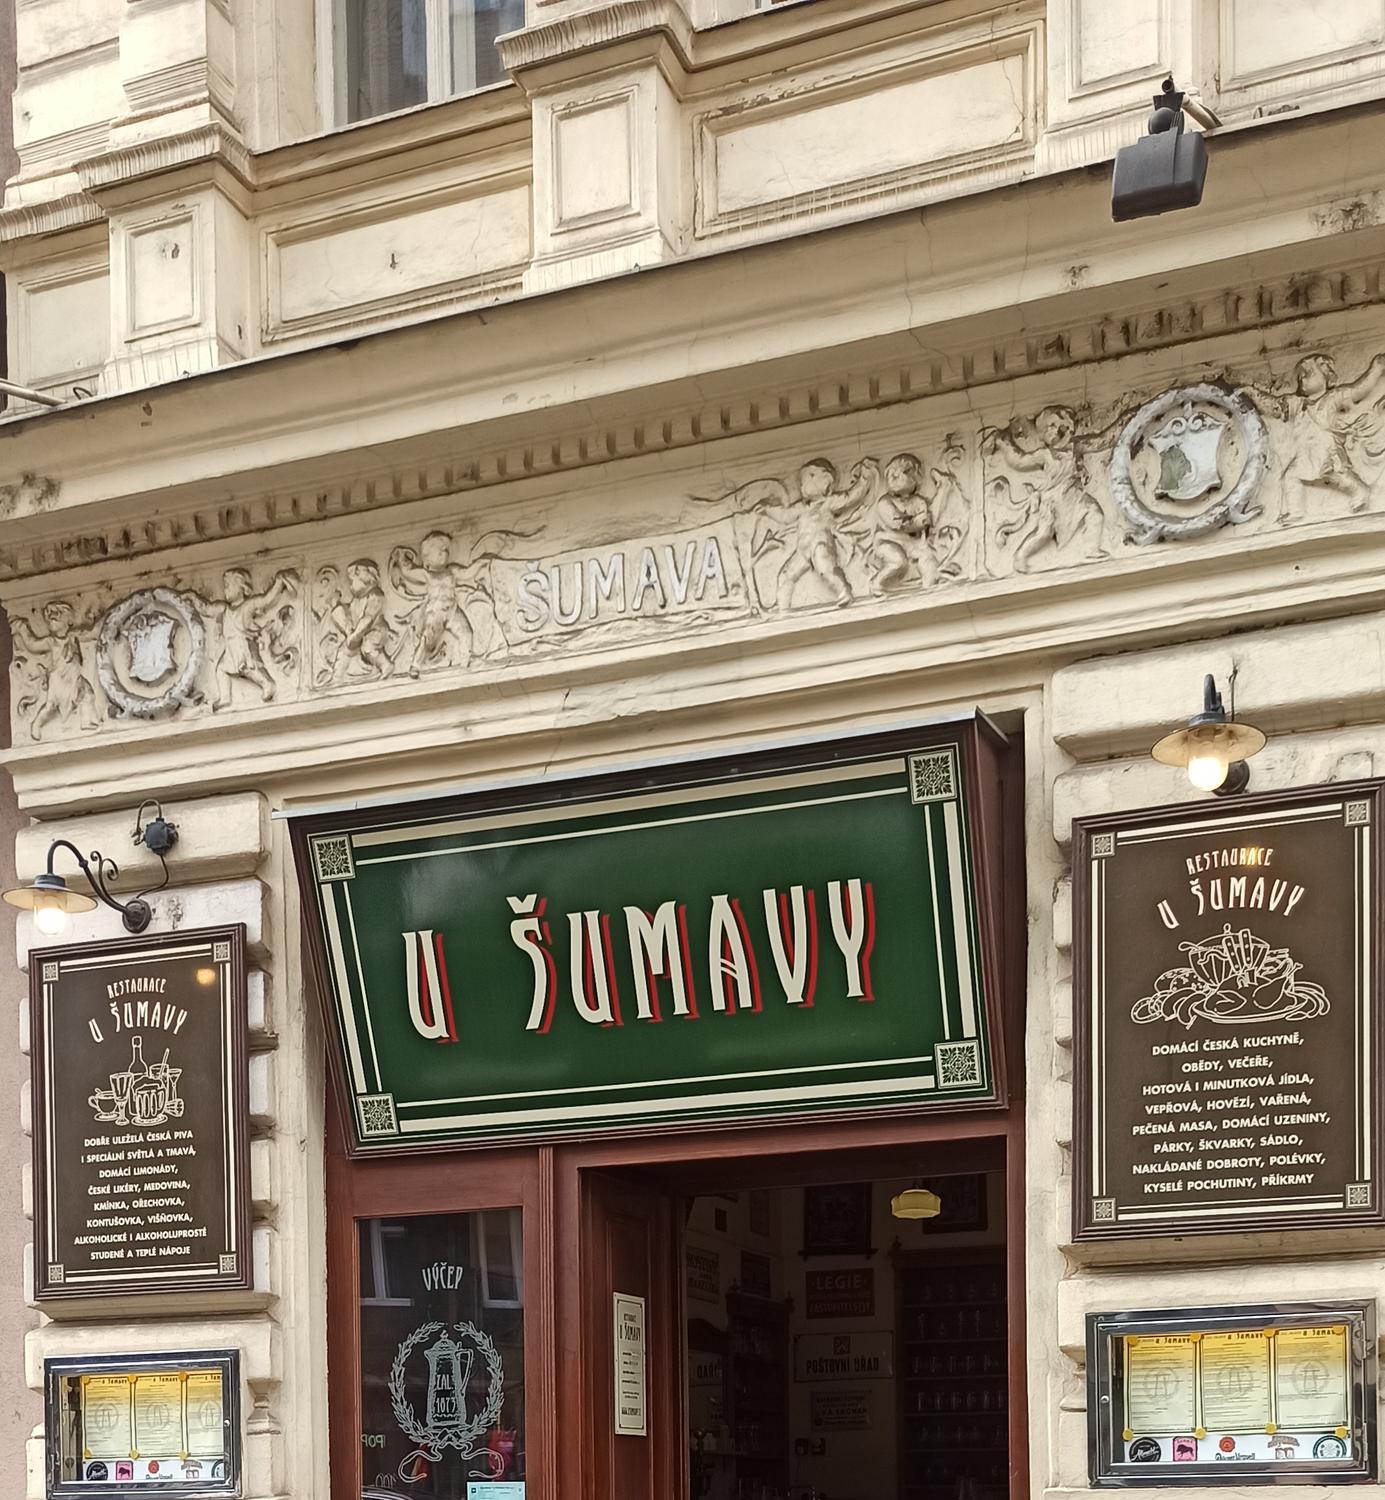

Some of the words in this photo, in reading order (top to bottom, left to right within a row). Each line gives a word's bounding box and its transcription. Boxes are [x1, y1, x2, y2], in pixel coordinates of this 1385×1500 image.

[516, 535, 729, 633] ŠUMAVA
[1186, 847, 1274, 875] RESTAURACE
[1156, 899, 1179, 929] U
[1189, 875, 1305, 917] ŠUMAVY
[401, 929, 459, 1044] U
[506, 878, 875, 1035] ŠUMAVY
[107, 976, 166, 1000] RESTAURACE
[88, 1018, 105, 1043] U
[110, 1001, 188, 1035] ŠUMAVY
[1152, 1039, 1199, 1056] DOMÁCÍ
[1202, 1036, 1239, 1052] ČESKÁ
[1243, 1031, 1305, 1048] KUCHYNĚ,
[1181, 1059, 1224, 1073] OBĚDY,
[1227, 1054, 1273, 1069] VEČEŘE,
[1142, 1080, 1192, 1096] HOTOVÁ
[1202, 1073, 1275, 1091] MINUTKOVÁ
[1278, 1072, 1315, 1086] JÍDLA,
[1145, 1099, 1203, 1115] VEPŘOVÁ,
[1206, 1095, 1255, 1111] HOVĚZÍ,
[1259, 1091, 1312, 1107] VAŘENÁ,
[1132, 1120, 1176, 1136] PEČENÁ
[1179, 1120, 1218, 1133] MASA,
[1222, 1113, 1270, 1129] DOMÁCÍ
[1273, 1111, 1331, 1126] UZENINY,
[84, 1135, 111, 1147] DOBŘE
[111, 1132, 145, 1145] ULEŽELÁ
[146, 1130, 172, 1142] ČESKÁ
[173, 1129, 194, 1140] PIVA
[1153, 1141, 1195, 1154] PÁRKY,
[1198, 1137, 1256, 1151] ŠKVARKY,
[1259, 1133, 1304, 1147] SÁDLO,
[86, 1150, 125, 1164] SPECIÁLNÍ
[127, 1147, 155, 1160] SVĚTLÁ
[165, 1144, 197, 1157] TMAVÁ,
[1132, 1158, 1203, 1175] NAKLÁDANÉ
[1206, 1156, 1265, 1170] DOBROTY,
[1269, 1152, 1326, 1166] POLÉVKY,
[99, 1166, 131, 1179] DOMÁCÍ
[133, 1163, 179, 1176] LIMONÁDY,
[87, 1183, 111, 1196] ČESKÉ
[113, 1182, 141, 1194] LIKÉRY,
[143, 1179, 191, 1192] MEDOVINA,
[1143, 1179, 1183, 1194] KYSELÉ
[1187, 1177, 1257, 1191] POCHUTINY,
[1261, 1173, 1315, 1187] PŘÍKRMY
[93, 1200, 130, 1211] KMÍNKA,
[131, 1196, 185, 1209] OŘECHOVKA,
[86, 1215, 145, 1228] KONTUŠOVKA,
[147, 1212, 193, 1224] VIŠŇOVKA,
[73, 1231, 127, 1245] ALKOHOLICKÉ
[135, 1226, 207, 1241] ALKOHOLUPROSTÉ
[90, 1248, 125, 1261] STUDENÉ
[135, 1246, 157, 1258] TEPLÉ
[159, 1245, 191, 1256] NÁPOJE
[421, 1261, 463, 1291] VÝČEP
[815, 1273, 863, 1291] LEGIE
[806, 1355, 850, 1374] POŠTOVNÍ
[854, 1353, 880, 1372] ÚŘAD
